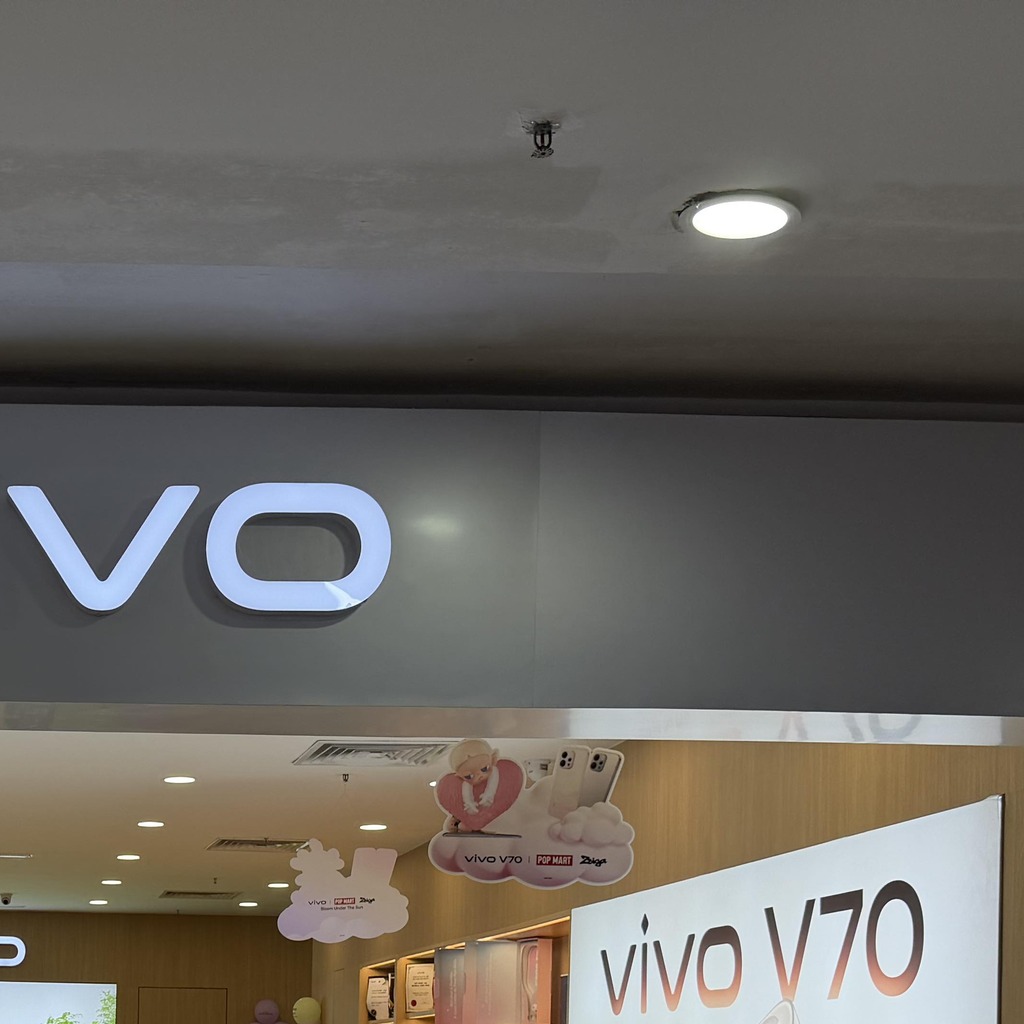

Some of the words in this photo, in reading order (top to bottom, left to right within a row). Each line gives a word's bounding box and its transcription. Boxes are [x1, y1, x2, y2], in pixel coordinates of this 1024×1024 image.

[464, 854, 496, 863] vivo
[499, 855, 523, 864] V70
[537, 856, 551, 864] POP
[552, 856, 572, 865] MART
[600, 913, 743, 1016] vivo
[764, 879, 925, 1002] V70
